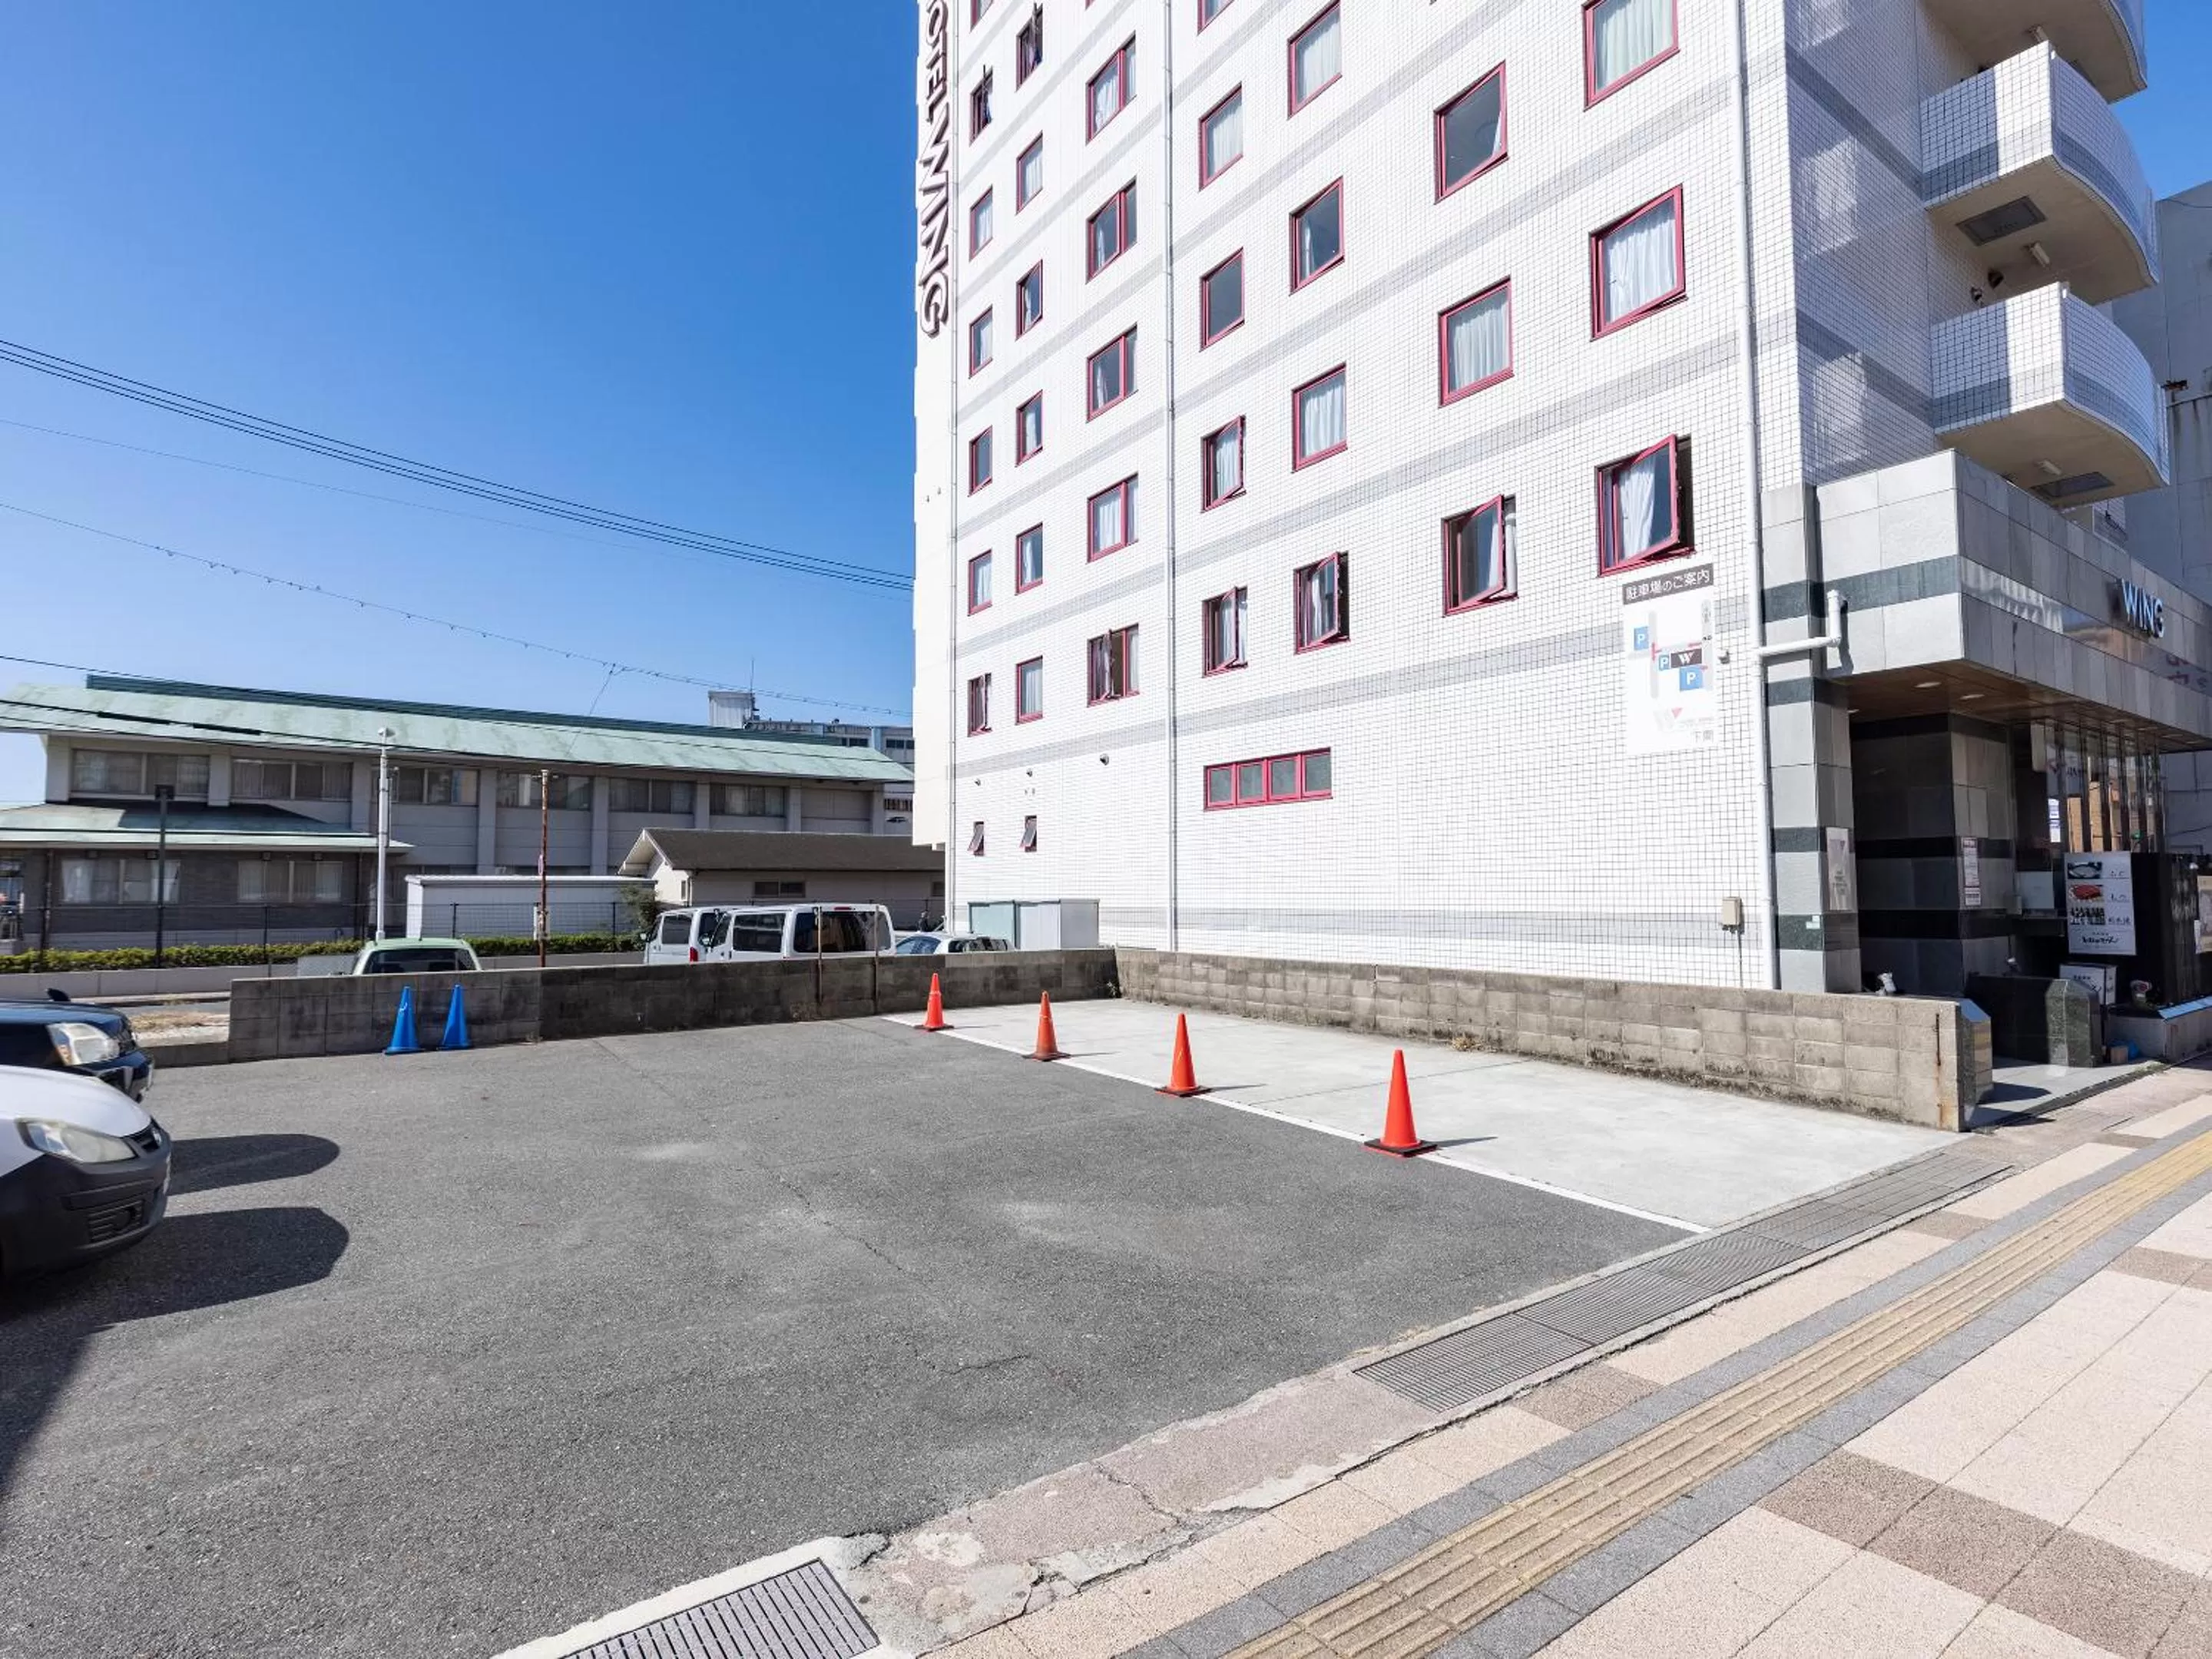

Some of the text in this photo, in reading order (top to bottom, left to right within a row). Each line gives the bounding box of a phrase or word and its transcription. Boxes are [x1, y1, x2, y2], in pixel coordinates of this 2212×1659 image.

[919, 0, 950, 339] OTEL WING
[1626, 569, 1710, 600] 駐車場のご案内
[2121, 578, 2164, 638] WING
